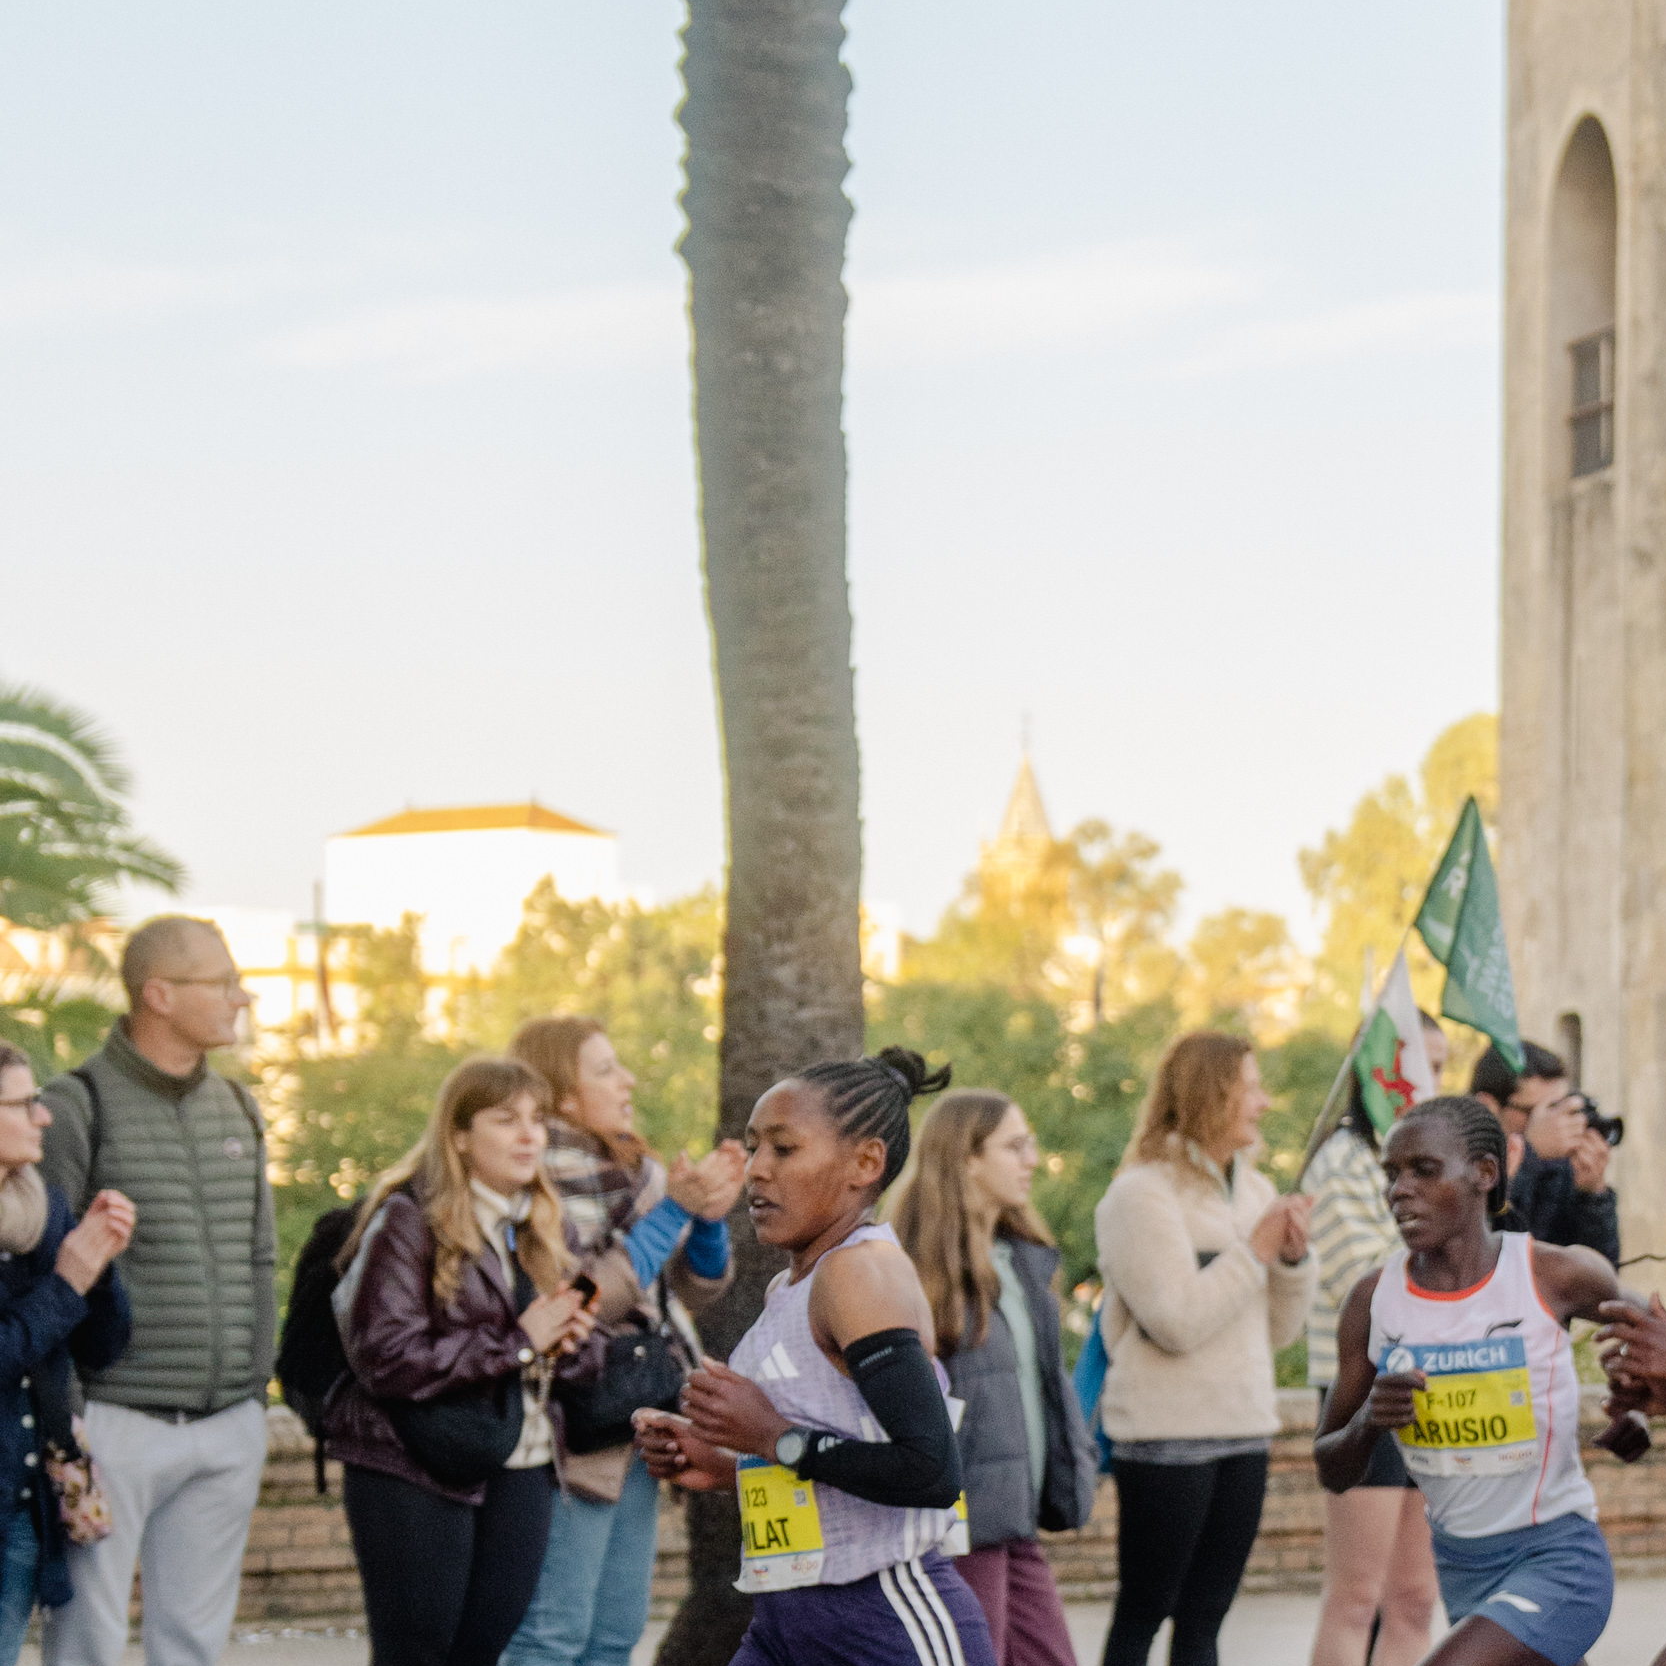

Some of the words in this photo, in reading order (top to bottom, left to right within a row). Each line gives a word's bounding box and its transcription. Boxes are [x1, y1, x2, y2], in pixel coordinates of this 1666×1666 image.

[1422, 1345, 1508, 1372] ZURICH
[1424, 1388, 1477, 1410] F-107
[1413, 1415, 1508, 1444] ARUSIO
